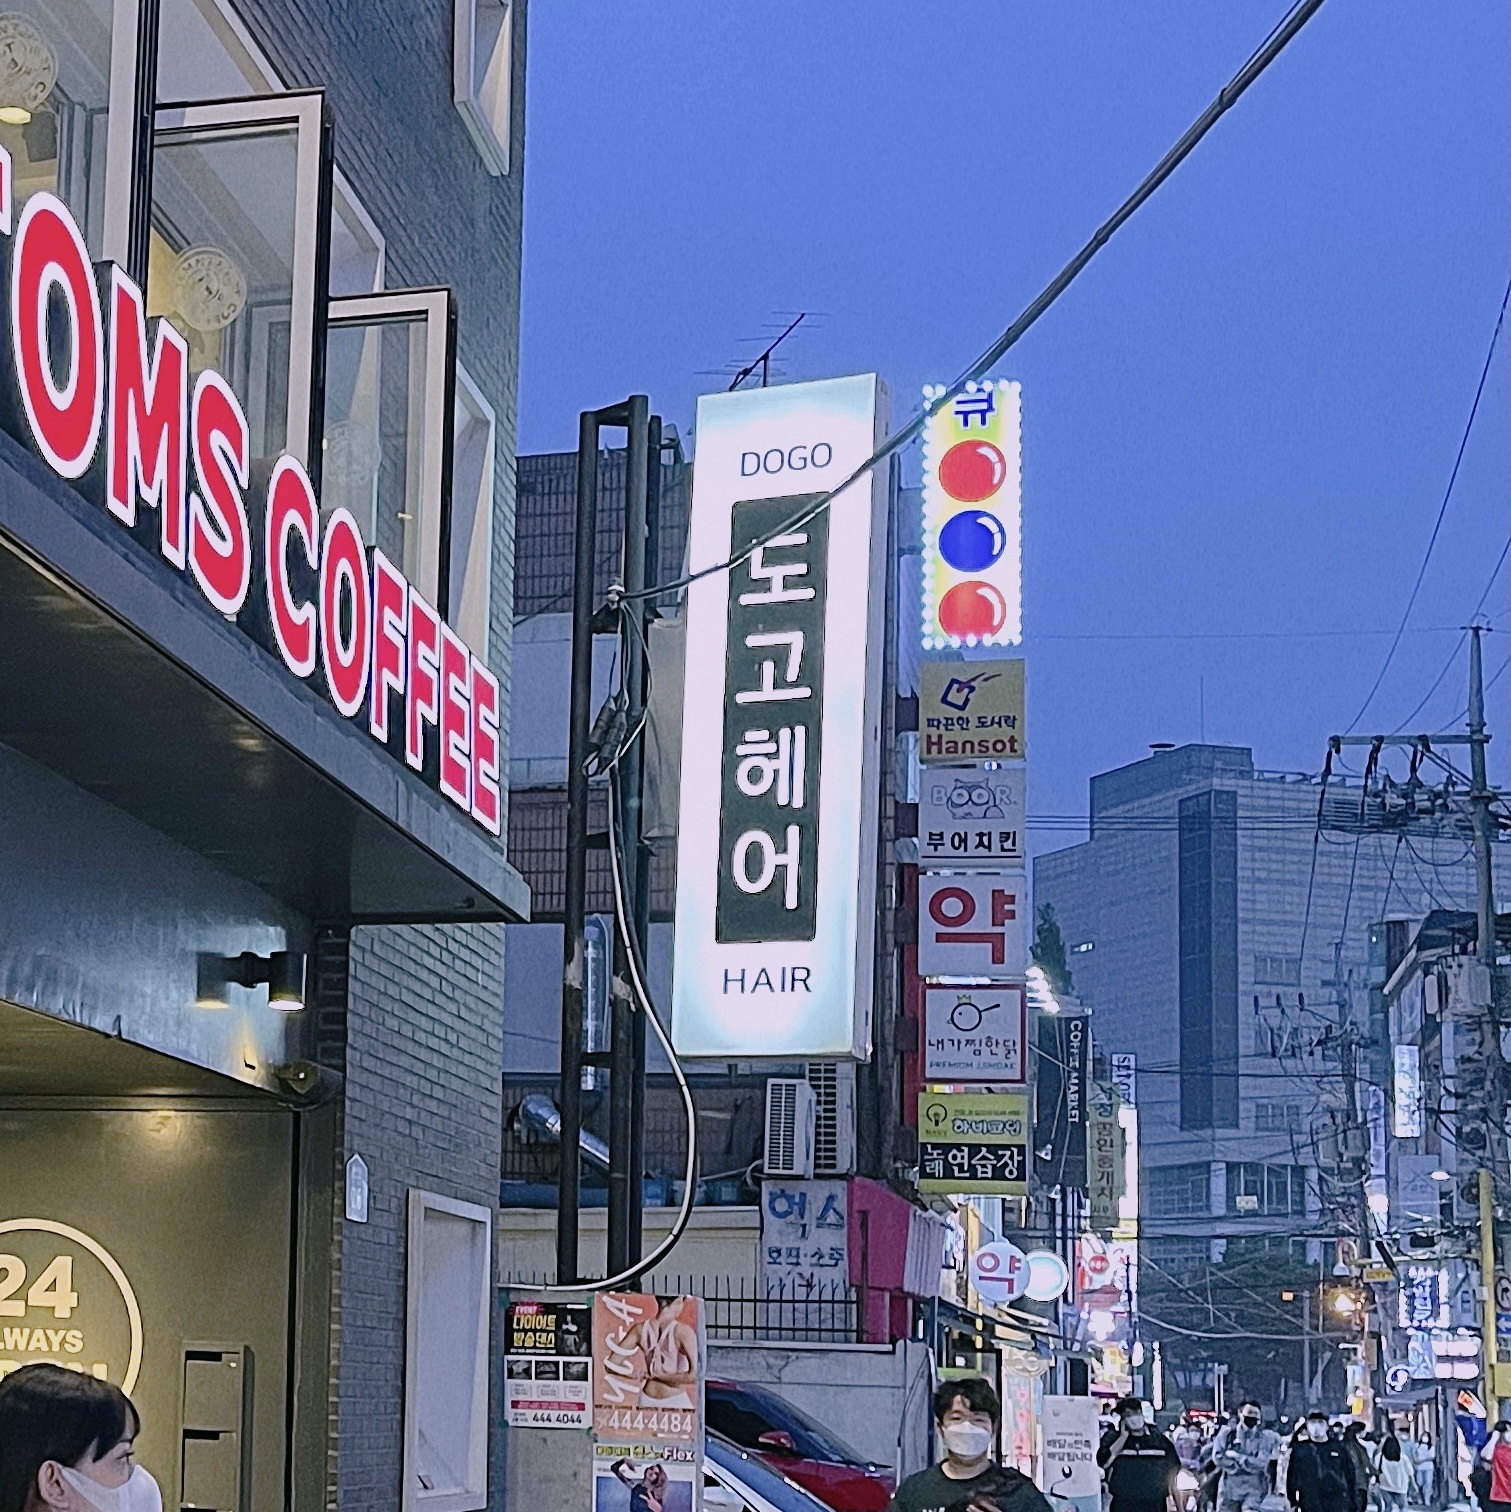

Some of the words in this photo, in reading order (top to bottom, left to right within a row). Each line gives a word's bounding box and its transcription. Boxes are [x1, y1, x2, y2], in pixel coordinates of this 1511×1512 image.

[740, 442, 833, 477] DOGO
[265, 455, 501, 838] COFFEE
[732, 532, 816, 910] 도고헤어
[925, 733, 1019, 755] Hansot
[926, 829, 1018, 853] 부어치킨
[928, 886, 1017, 965] 약
[722, 965, 813, 994] HAIR
[976, 1251, 1022, 1295] 약
